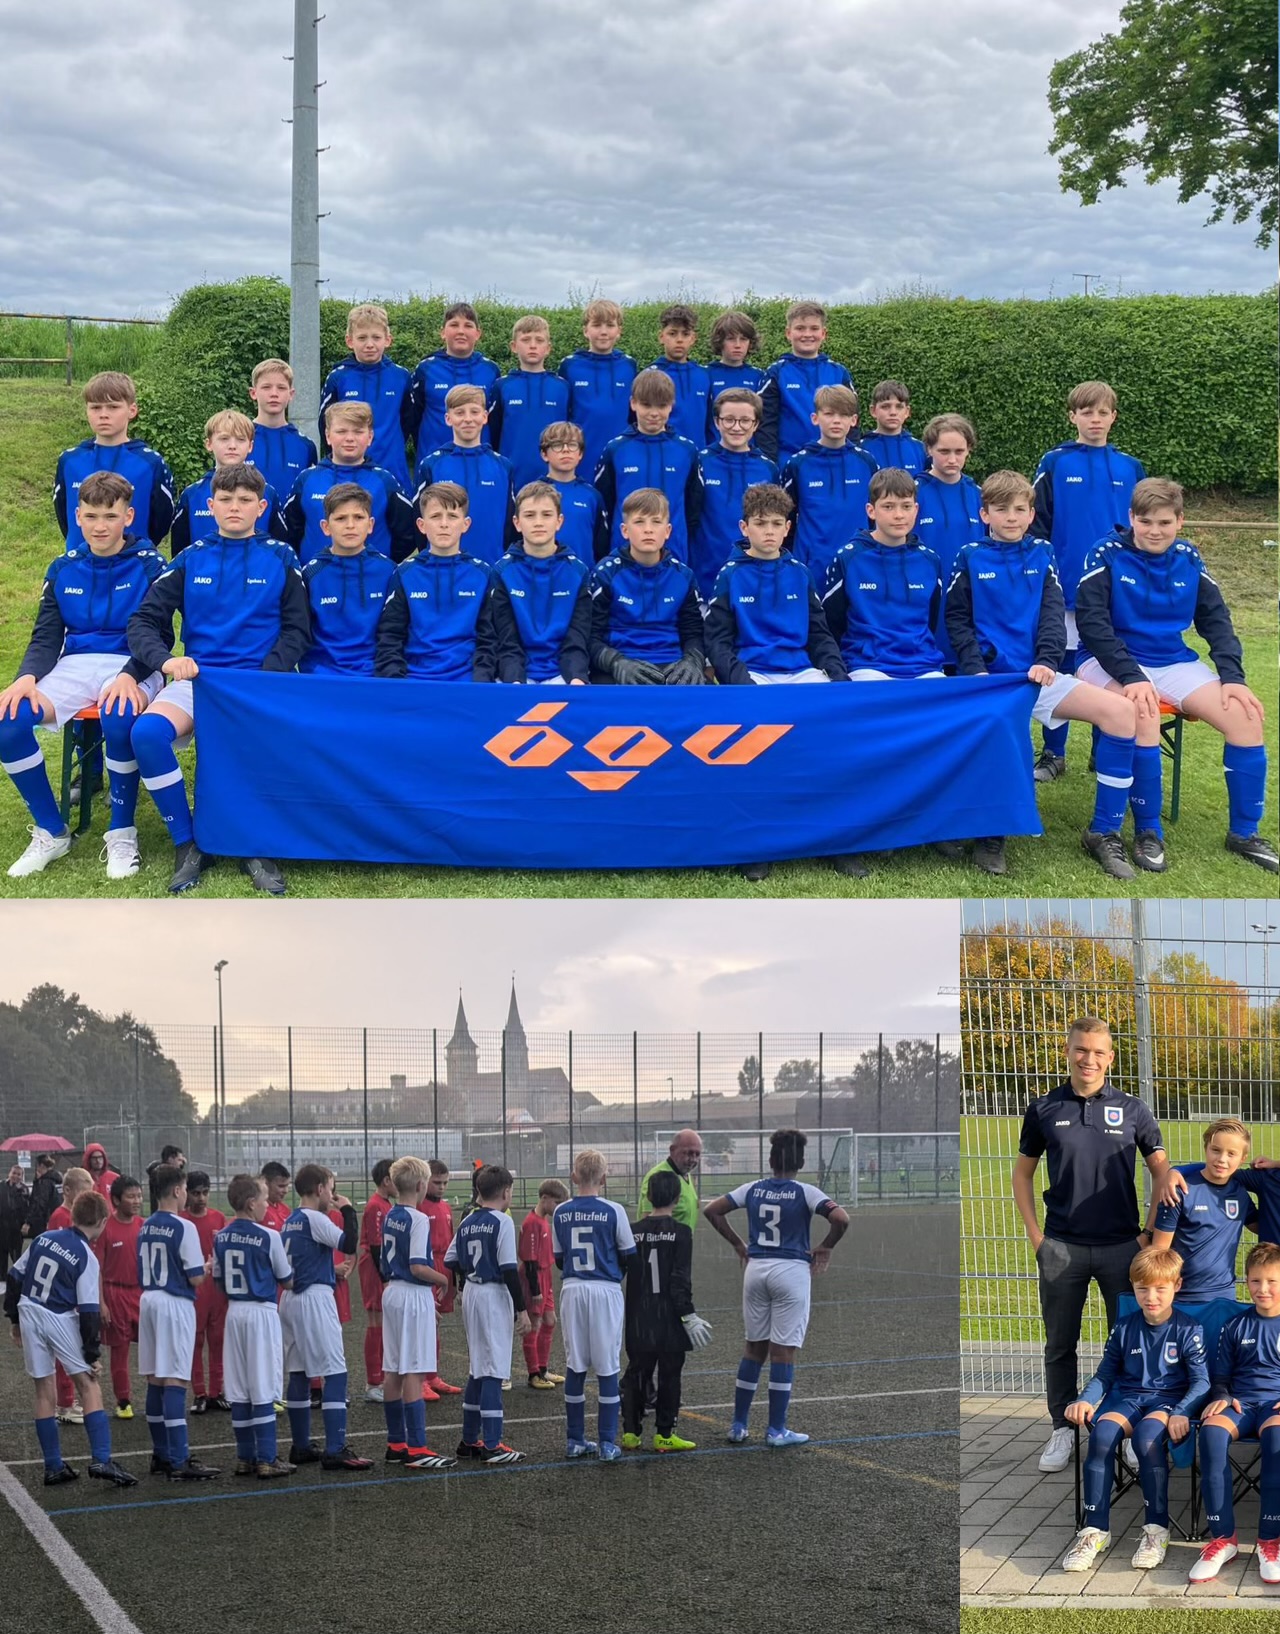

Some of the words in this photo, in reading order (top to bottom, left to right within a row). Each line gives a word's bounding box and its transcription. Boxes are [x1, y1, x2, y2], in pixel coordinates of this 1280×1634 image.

[1120, 575, 1136, 585] JAKO
[64, 587, 83, 595] JAKO
[410, 591, 428, 599] JAKO
[511, 588, 525, 598] JAKO
[618, 595, 633, 605] JAKO
[753, 1188, 765, 1200] TSV
[766, 1189, 796, 1200] Bitzfeld
[559, 1212, 573, 1223] TSV
[574, 1211, 608, 1222] Bitzfeld
[149, 1225, 175, 1238] Bitzfeld
[286, 1221, 303, 1231] Bitzfeld
[387, 1217, 406, 1233] Bitzfeld
[460, 1226, 469, 1237] TSV
[469, 1224, 494, 1235] Bitzfeld
[757, 1204, 782, 1247] 3
[217, 1233, 231, 1243] TSV
[231, 1233, 262, 1246] Bitzfeld
[646, 1232, 676, 1242] Bitzfeld
[37, 1236, 50, 1248] TSV
[49, 1242, 79, 1266] Bitzfeld
[571, 1226, 596, 1272] 5
[139, 1242, 169, 1287] 10
[467, 1240, 483, 1284] 2
[224, 1249, 248, 1295] 6
[648, 1248, 661, 1294] 1
[30, 1255, 58, 1303] 9
[658, 1438, 674, 1447] FILA
